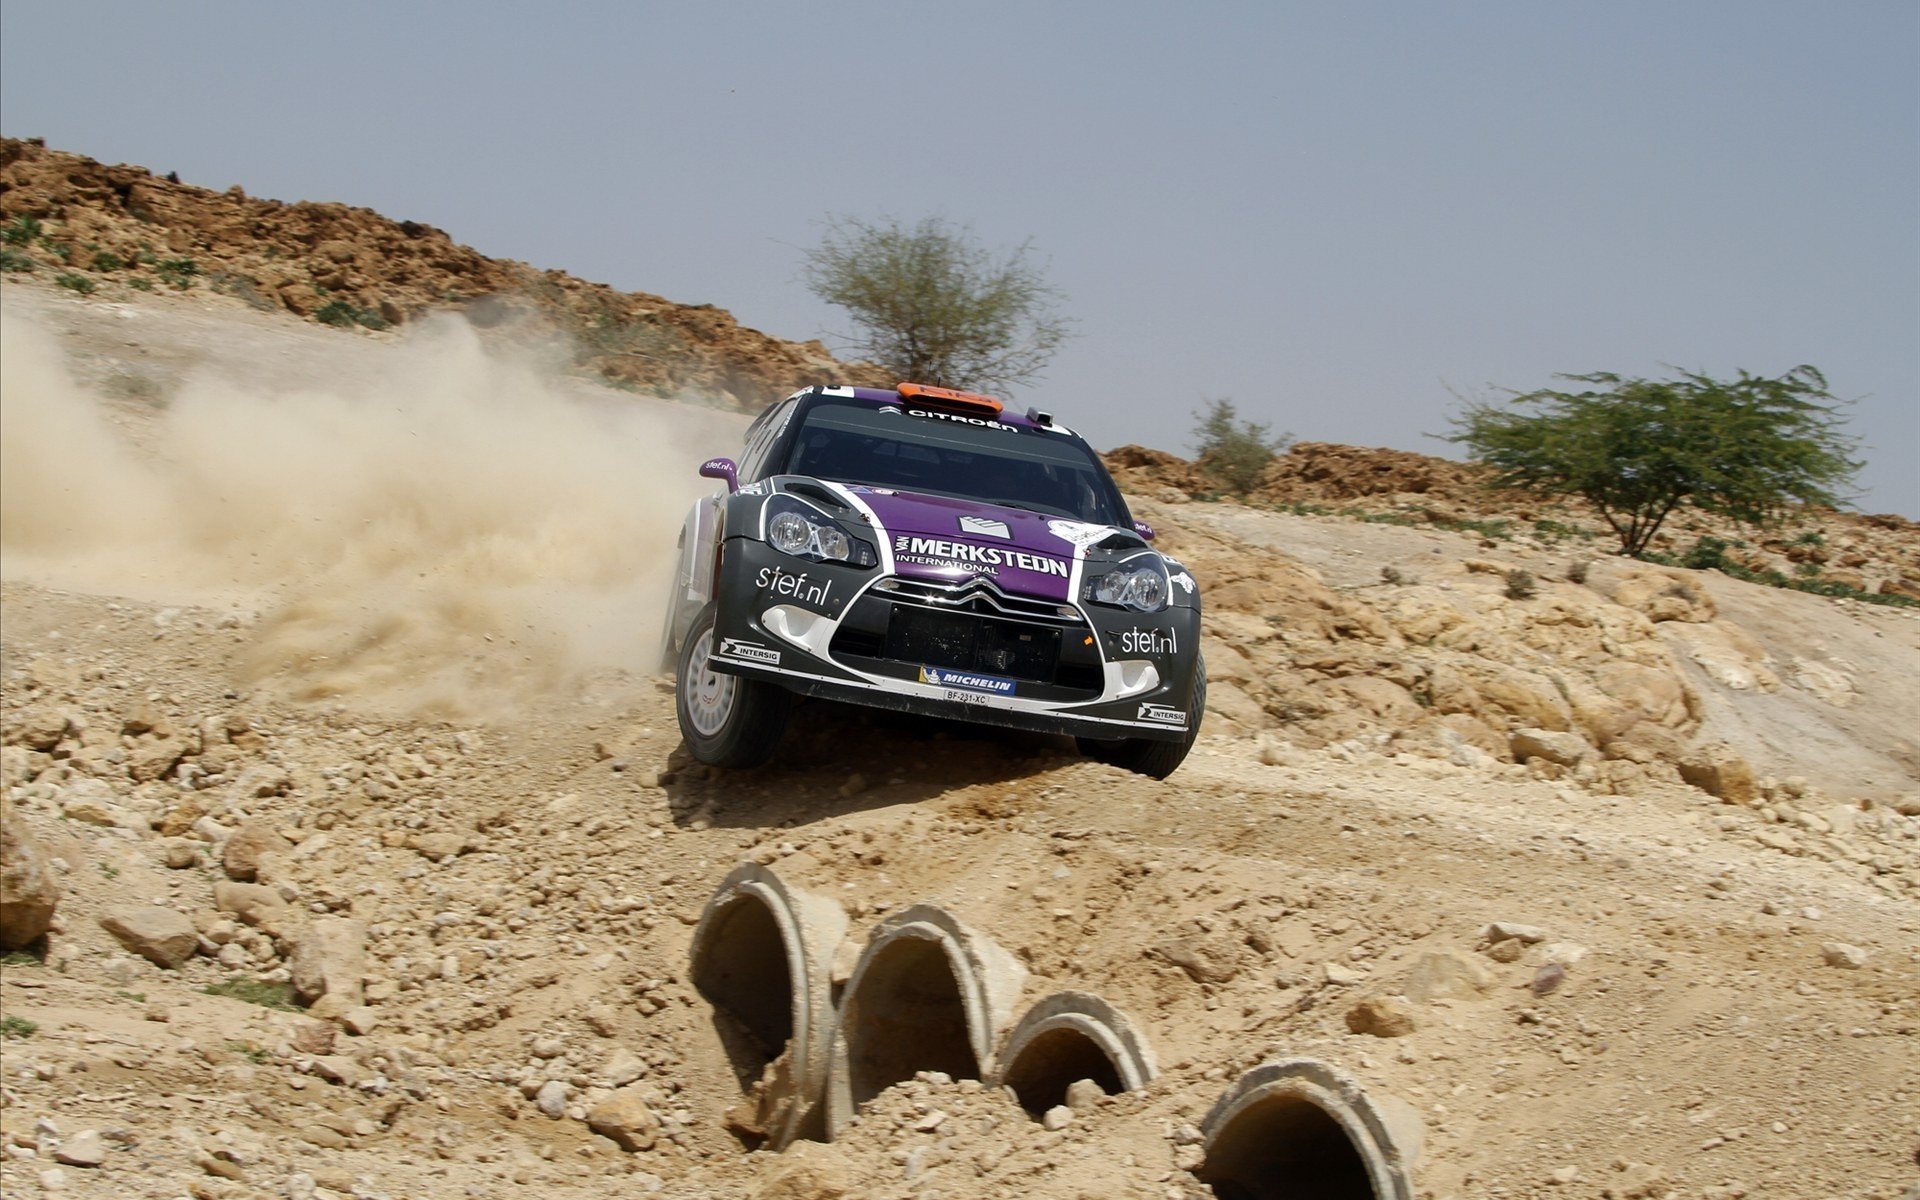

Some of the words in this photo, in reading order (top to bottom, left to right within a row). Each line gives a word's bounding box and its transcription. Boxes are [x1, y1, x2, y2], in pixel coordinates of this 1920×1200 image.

[895, 535, 910, 551] VAN
[896, 554, 999, 575] INTERNATIONAL
[755, 566, 832, 606] stef.nl
[1122, 626, 1177, 653] stef.nl
[740, 648, 778, 660] INTERSIG
[943, 673, 1011, 691] MICHELIN
[947, 691, 986, 704] BF-231-XC
[1153, 711, 1185, 720] INTERSIG
